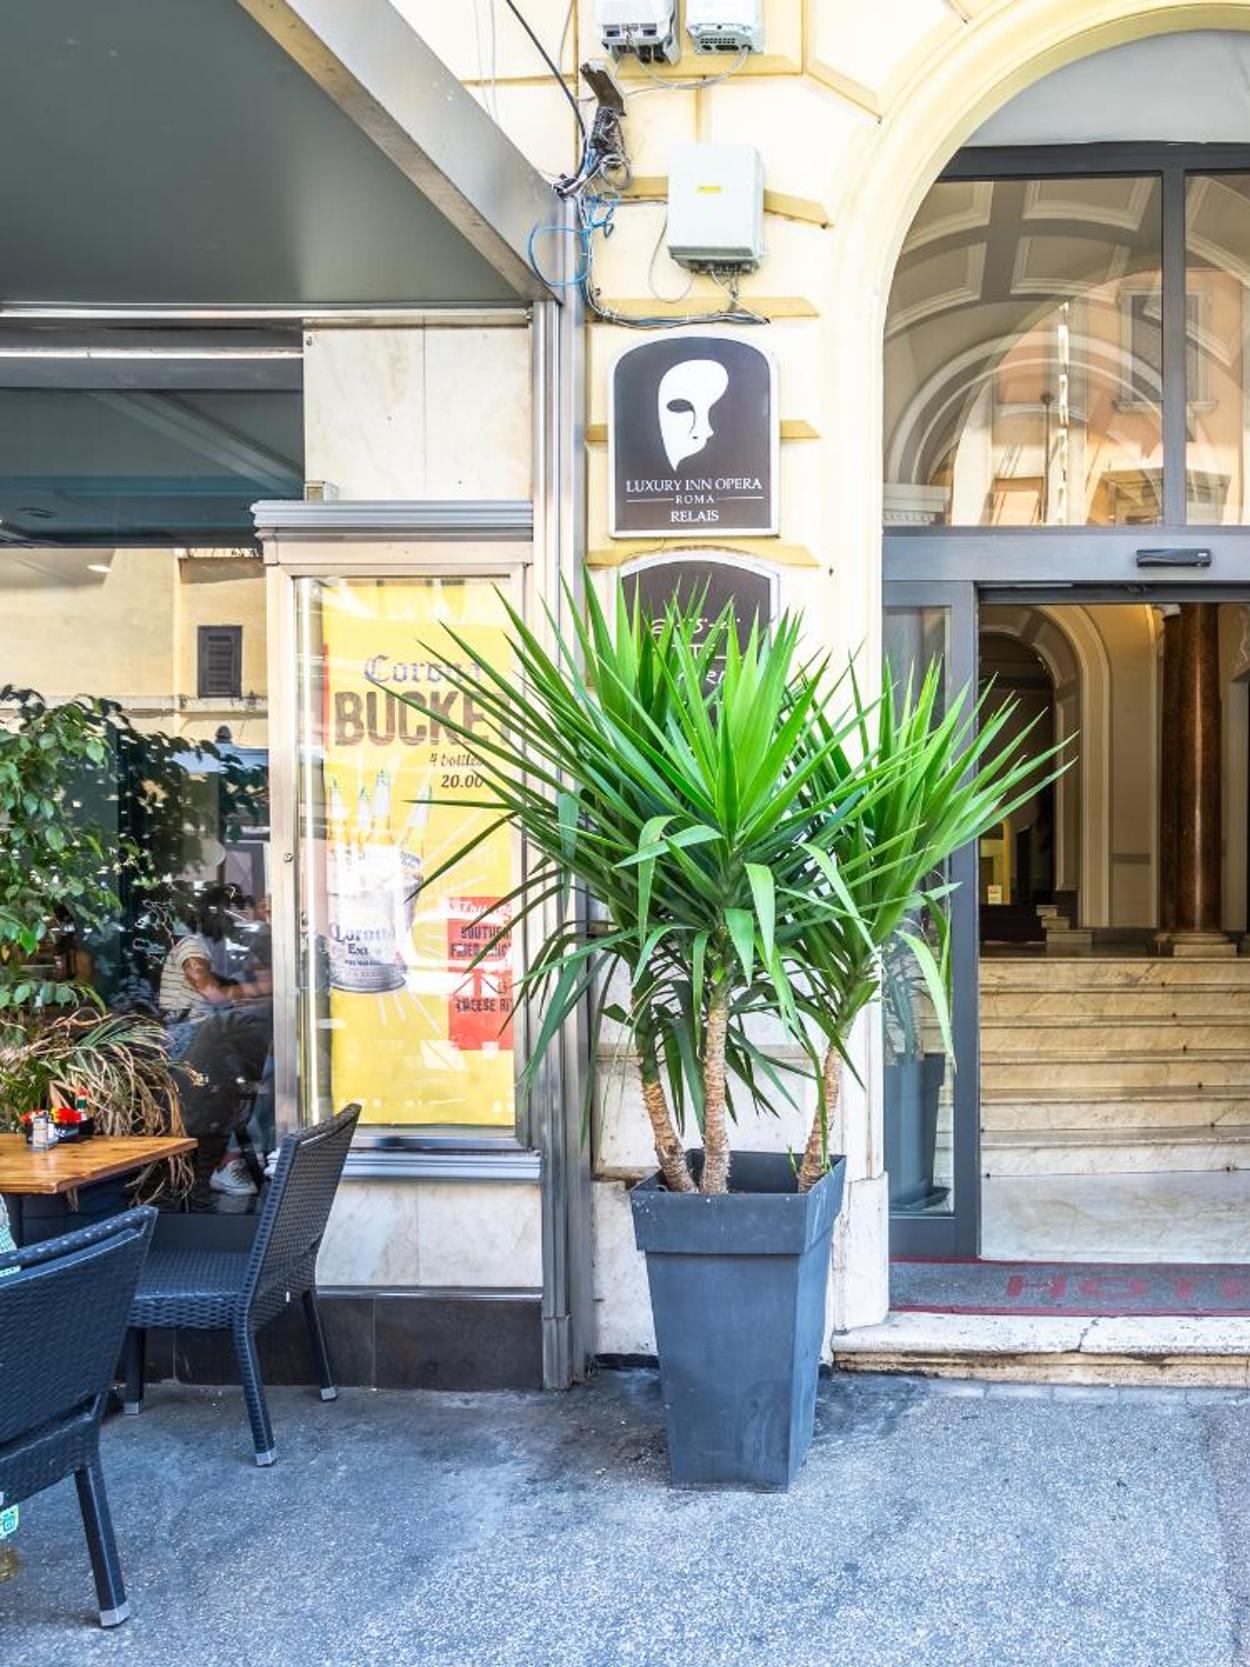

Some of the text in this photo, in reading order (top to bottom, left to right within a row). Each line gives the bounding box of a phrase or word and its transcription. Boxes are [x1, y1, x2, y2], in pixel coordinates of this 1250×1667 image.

[625, 477, 762, 493] LUXURY INN OPERA
[675, 495, 715, 504] ROMA
[670, 509, 720, 523] RELAIS
[441, 774, 484, 788] 20.00
